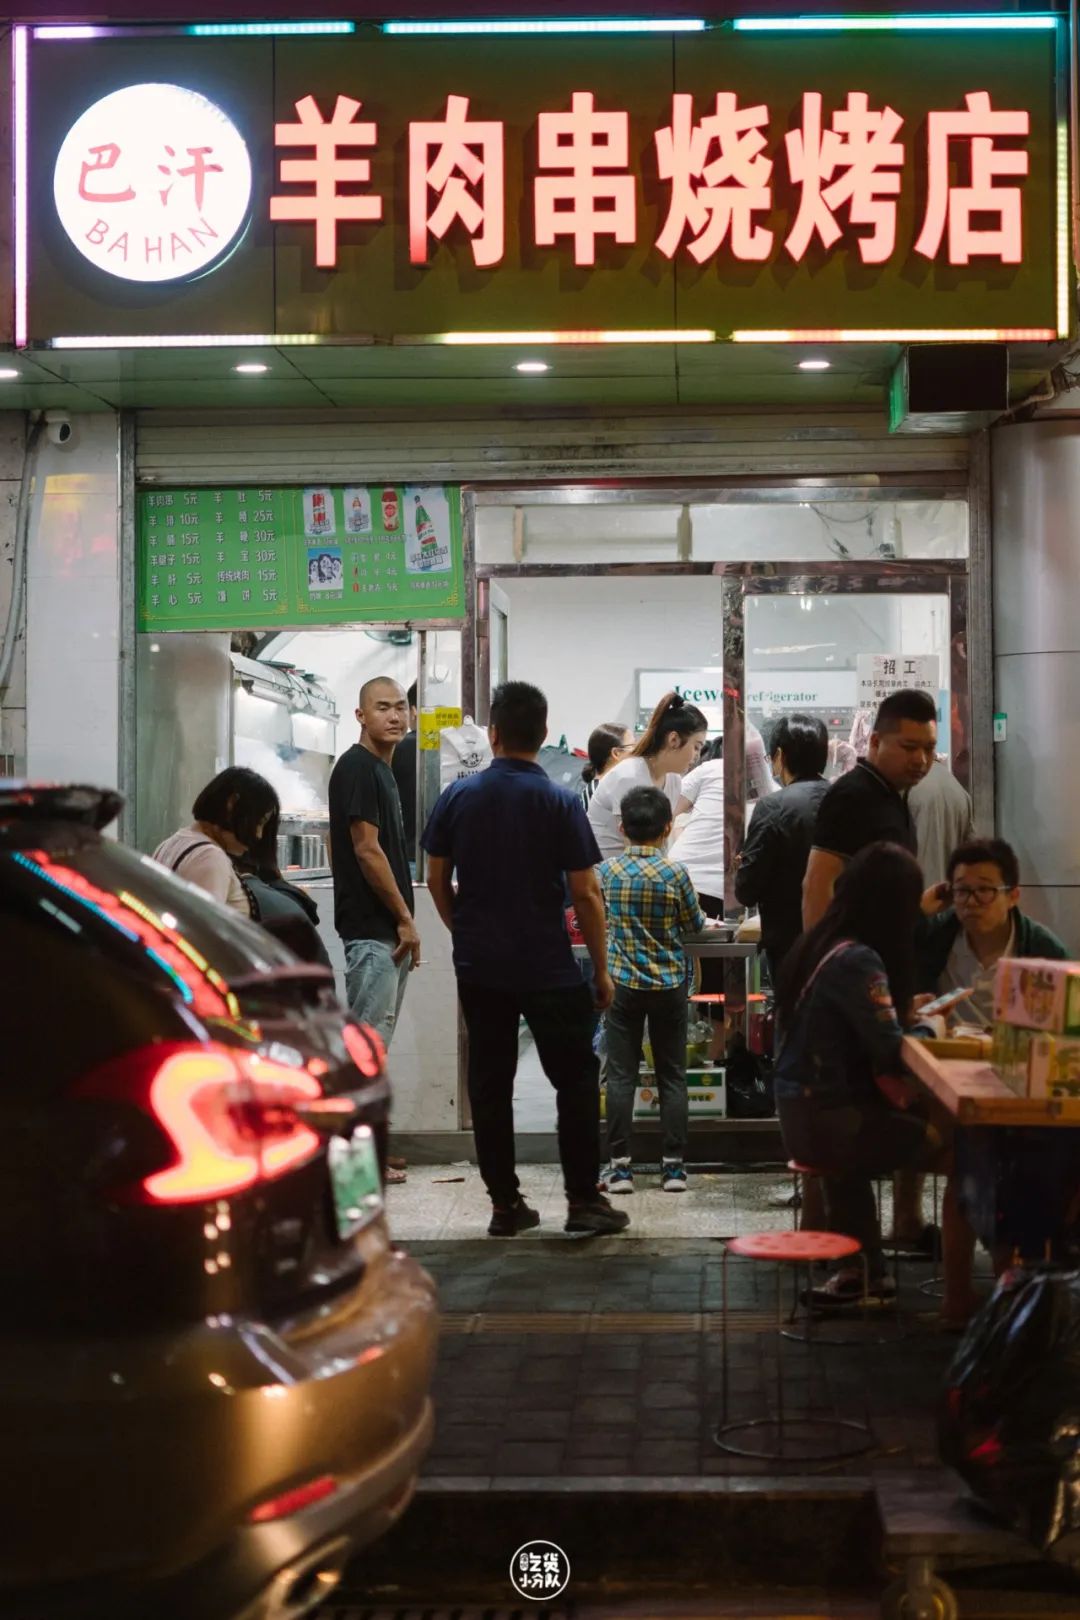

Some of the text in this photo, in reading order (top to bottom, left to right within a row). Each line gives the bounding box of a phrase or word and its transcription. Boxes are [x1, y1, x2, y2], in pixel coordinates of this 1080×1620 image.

[78, 142, 224, 213] 巴汗
[270, 92, 1030, 267] 羊肉串烧烤店
[85, 218, 219, 263] BAHAN
[184, 492, 198, 505] 5元
[258, 490, 272, 502] 5元
[180, 512, 199, 526] 10元
[253, 510, 274, 522] 25元
[182, 533, 200, 546] 15元
[255, 530, 275, 542] 30元
[182, 552, 201, 565] 15元
[255, 550, 276, 562] 30元
[186, 572, 202, 585] 5元
[258, 569, 277, 581] 15元
[187, 592, 202, 605] 5元
[263, 589, 278, 601] 5元
[883, 659, 917, 675] 招工
